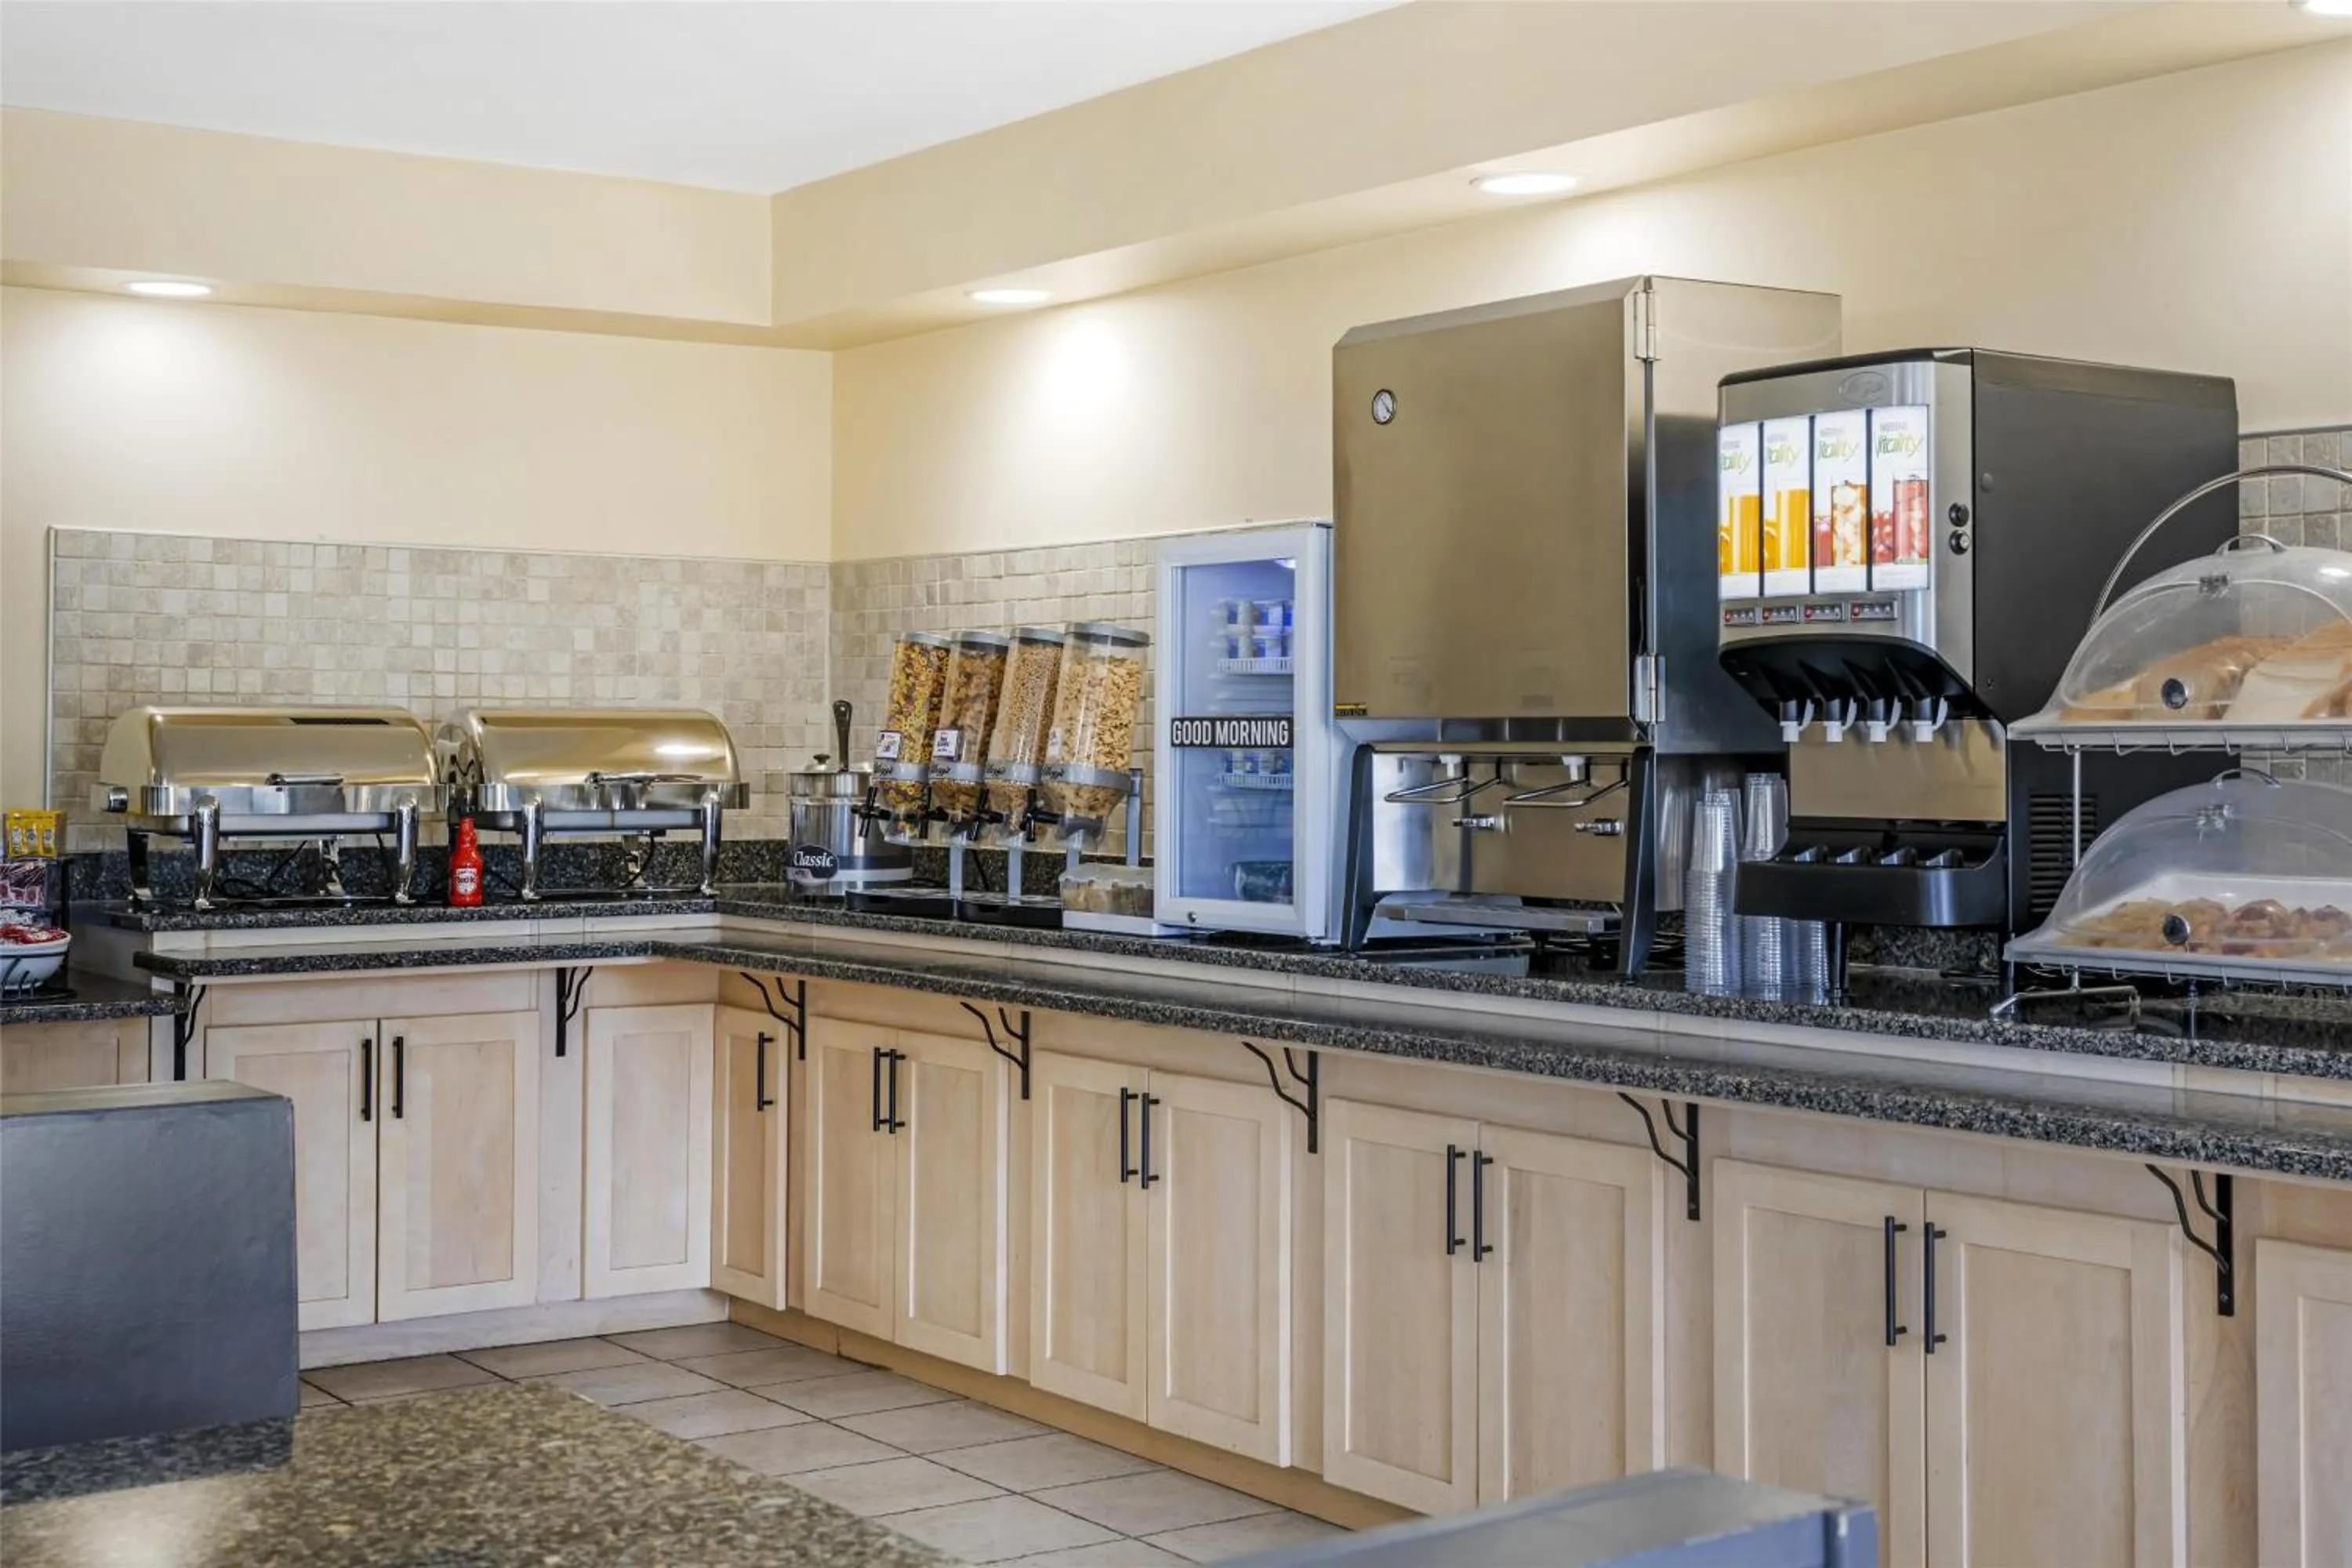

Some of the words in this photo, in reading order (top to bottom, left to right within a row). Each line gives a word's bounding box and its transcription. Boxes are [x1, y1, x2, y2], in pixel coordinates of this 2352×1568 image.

[1172, 720, 1212, 745] GOOD
[1216, 720, 1290, 746] MORNING
[793, 851, 834, 867] Classic
